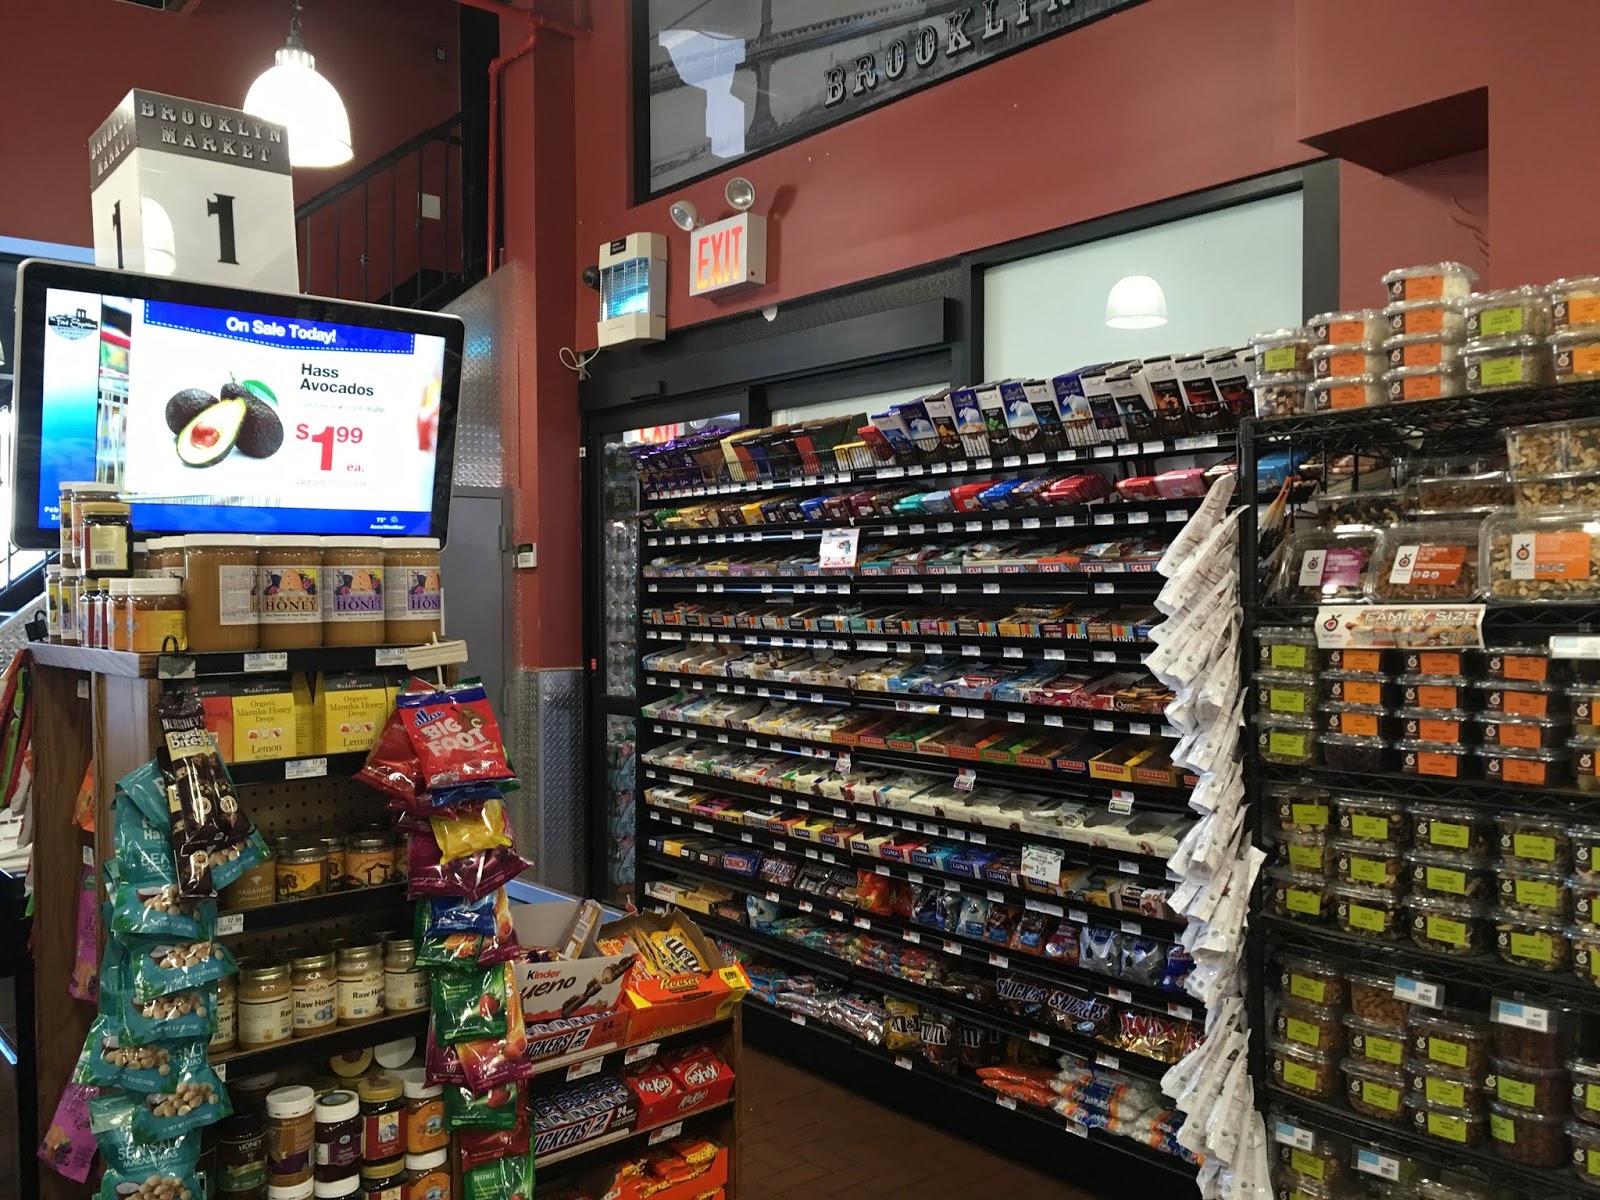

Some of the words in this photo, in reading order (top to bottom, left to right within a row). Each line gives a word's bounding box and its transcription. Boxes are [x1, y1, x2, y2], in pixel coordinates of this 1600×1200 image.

[140, 98, 283, 144] BROOKLYN
[161, 125, 272, 162] MARKET
[111, 199, 124, 270] 1
[207, 193, 240, 265] 1
[697, 225, 745, 291] EXIT
[226, 316, 249, 332] On
[252, 319, 286, 338] Sale
[288, 323, 337, 346] Today!
[300, 363, 338, 379] Hass
[300, 378, 374, 397] Avocados
[346, 464, 365, 473] ea.
[823, 556, 831, 566] 2
[1044, 564, 1059, 573] CLIF
[1086, 564, 1102, 573] CLIF
[1134, 563, 1152, 572] CLIF
[266, 600, 318, 611] HONEY
[1364, 610, 1431, 623] FAMILY
[1434, 609, 1478, 622] SIZE
[250, 699, 276, 709] Organic
[342, 695, 368, 704] Organic
[236, 707, 267, 718] Manuka
[268, 705, 292, 718] Honey
[329, 703, 360, 713] Manuka
[361, 700, 384, 712] Honey
[421, 716, 463, 740] BIG
[172, 729, 202, 740] snack
[171, 735, 205, 750] bites
[342, 737, 373, 748] Lemon
[427, 728, 486, 757] FOOT
[250, 743, 282, 755] Lemon
[853, 842, 868, 851] LUNA
[883, 848, 899, 857] LUNA
[915, 855, 932, 866] LUNA
[952, 862, 970, 873] LUNA
[988, 871, 1007, 883] LUNA
[520, 975, 577, 1000] ueno
[353, 990, 370, 999] Raw
[296, 998, 313, 1009] Raw
[314, 996, 336, 1009] Honey
[238, 1139, 263, 1152] HONEY
[474, 1172, 496, 1182] DEFENSE
